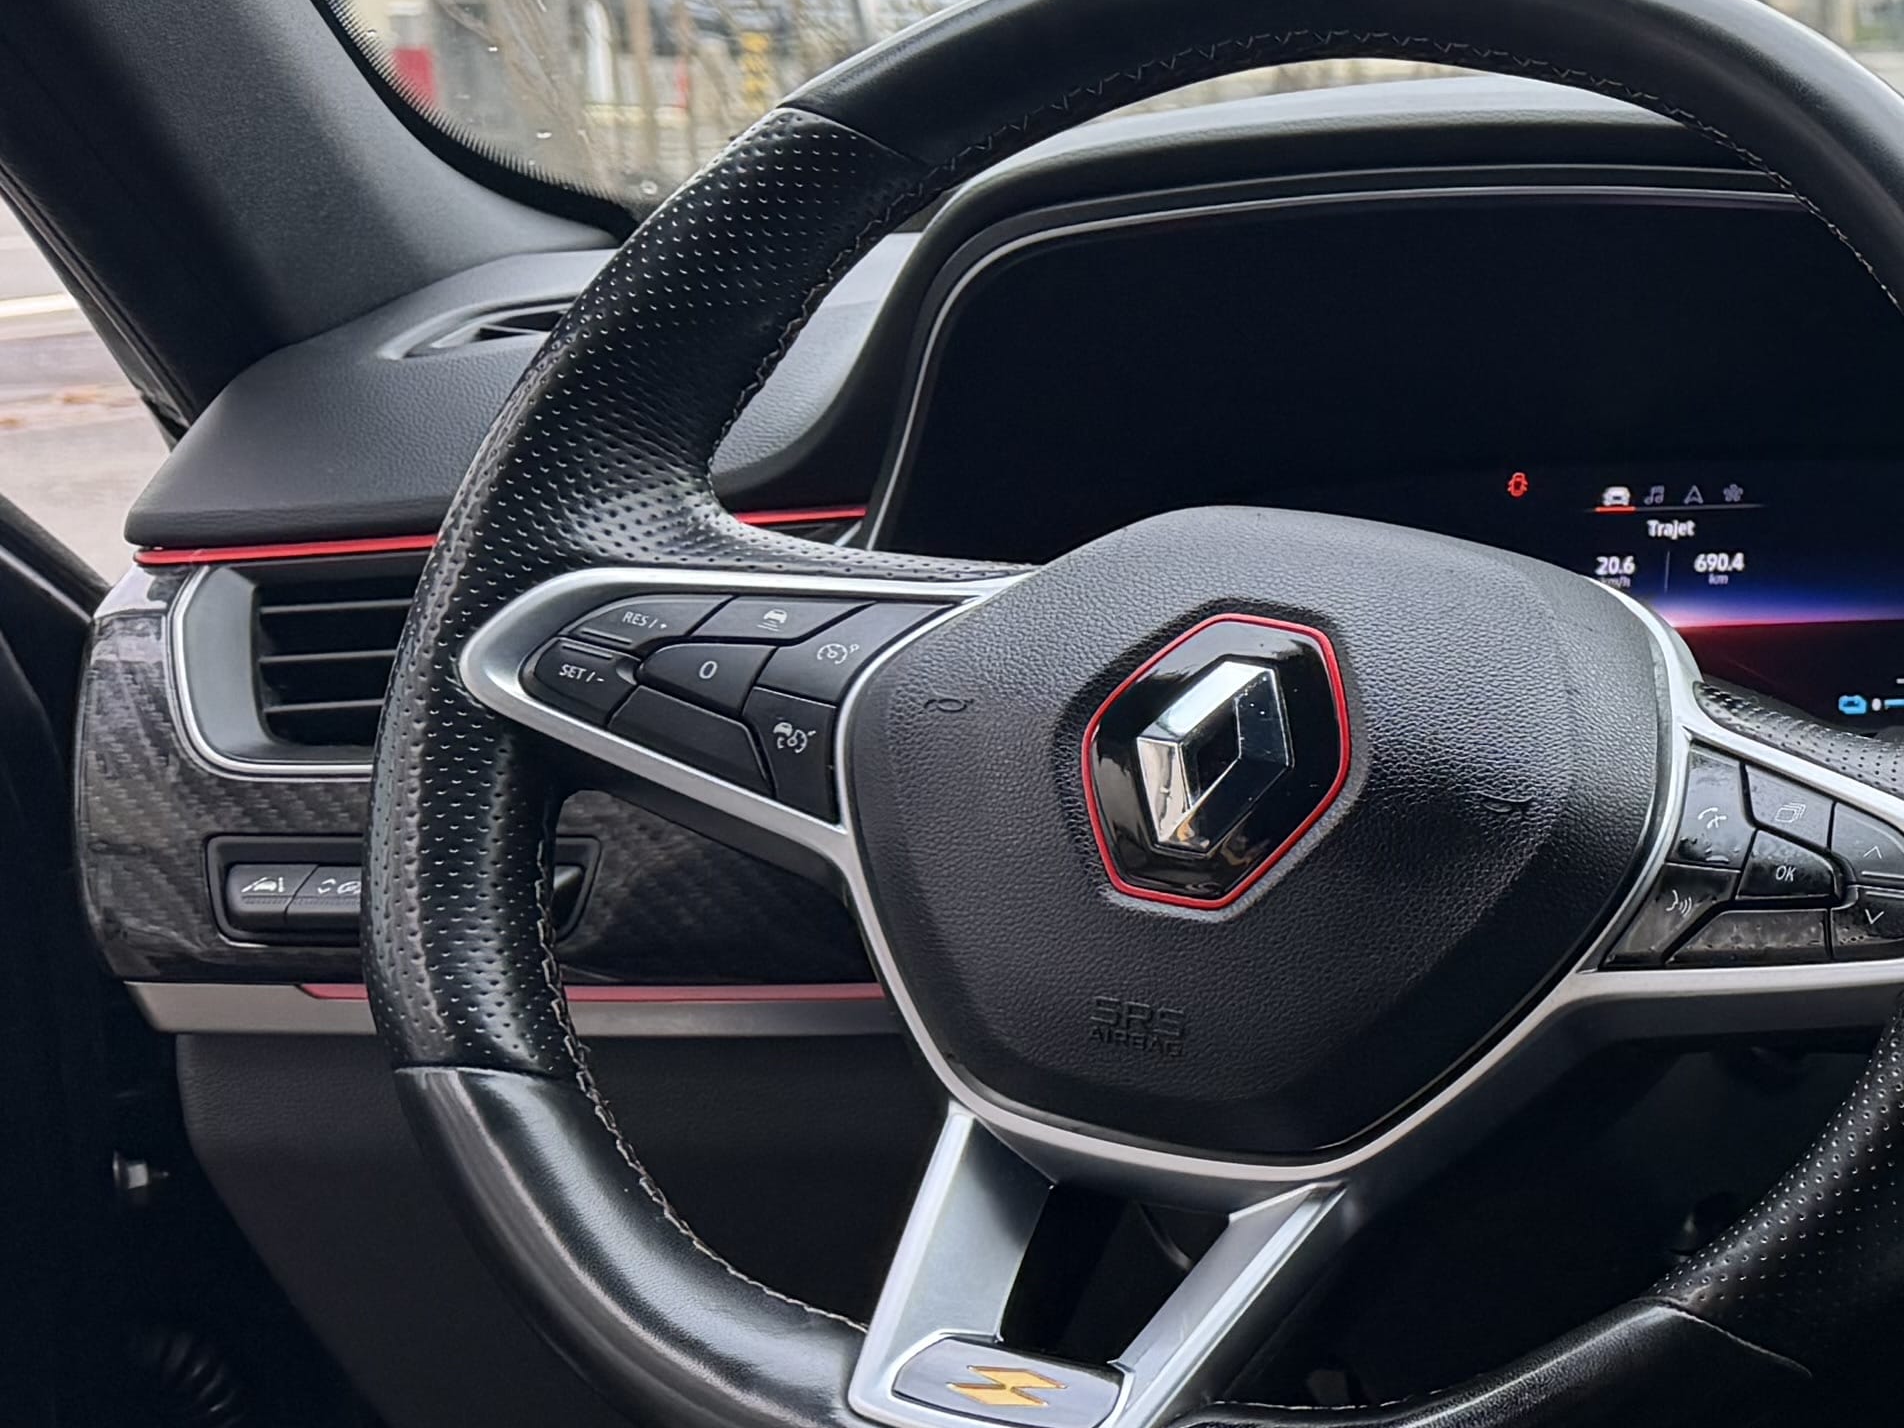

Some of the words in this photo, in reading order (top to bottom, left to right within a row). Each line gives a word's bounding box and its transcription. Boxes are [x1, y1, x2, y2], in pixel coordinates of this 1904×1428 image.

[1647, 519, 1696, 541] Trajet
[1595, 556, 1636, 576] 20.6
[1693, 552, 1745, 573] 690.4
[1708, 573, 1729, 586] km
[1775, 864, 1797, 884] OK
